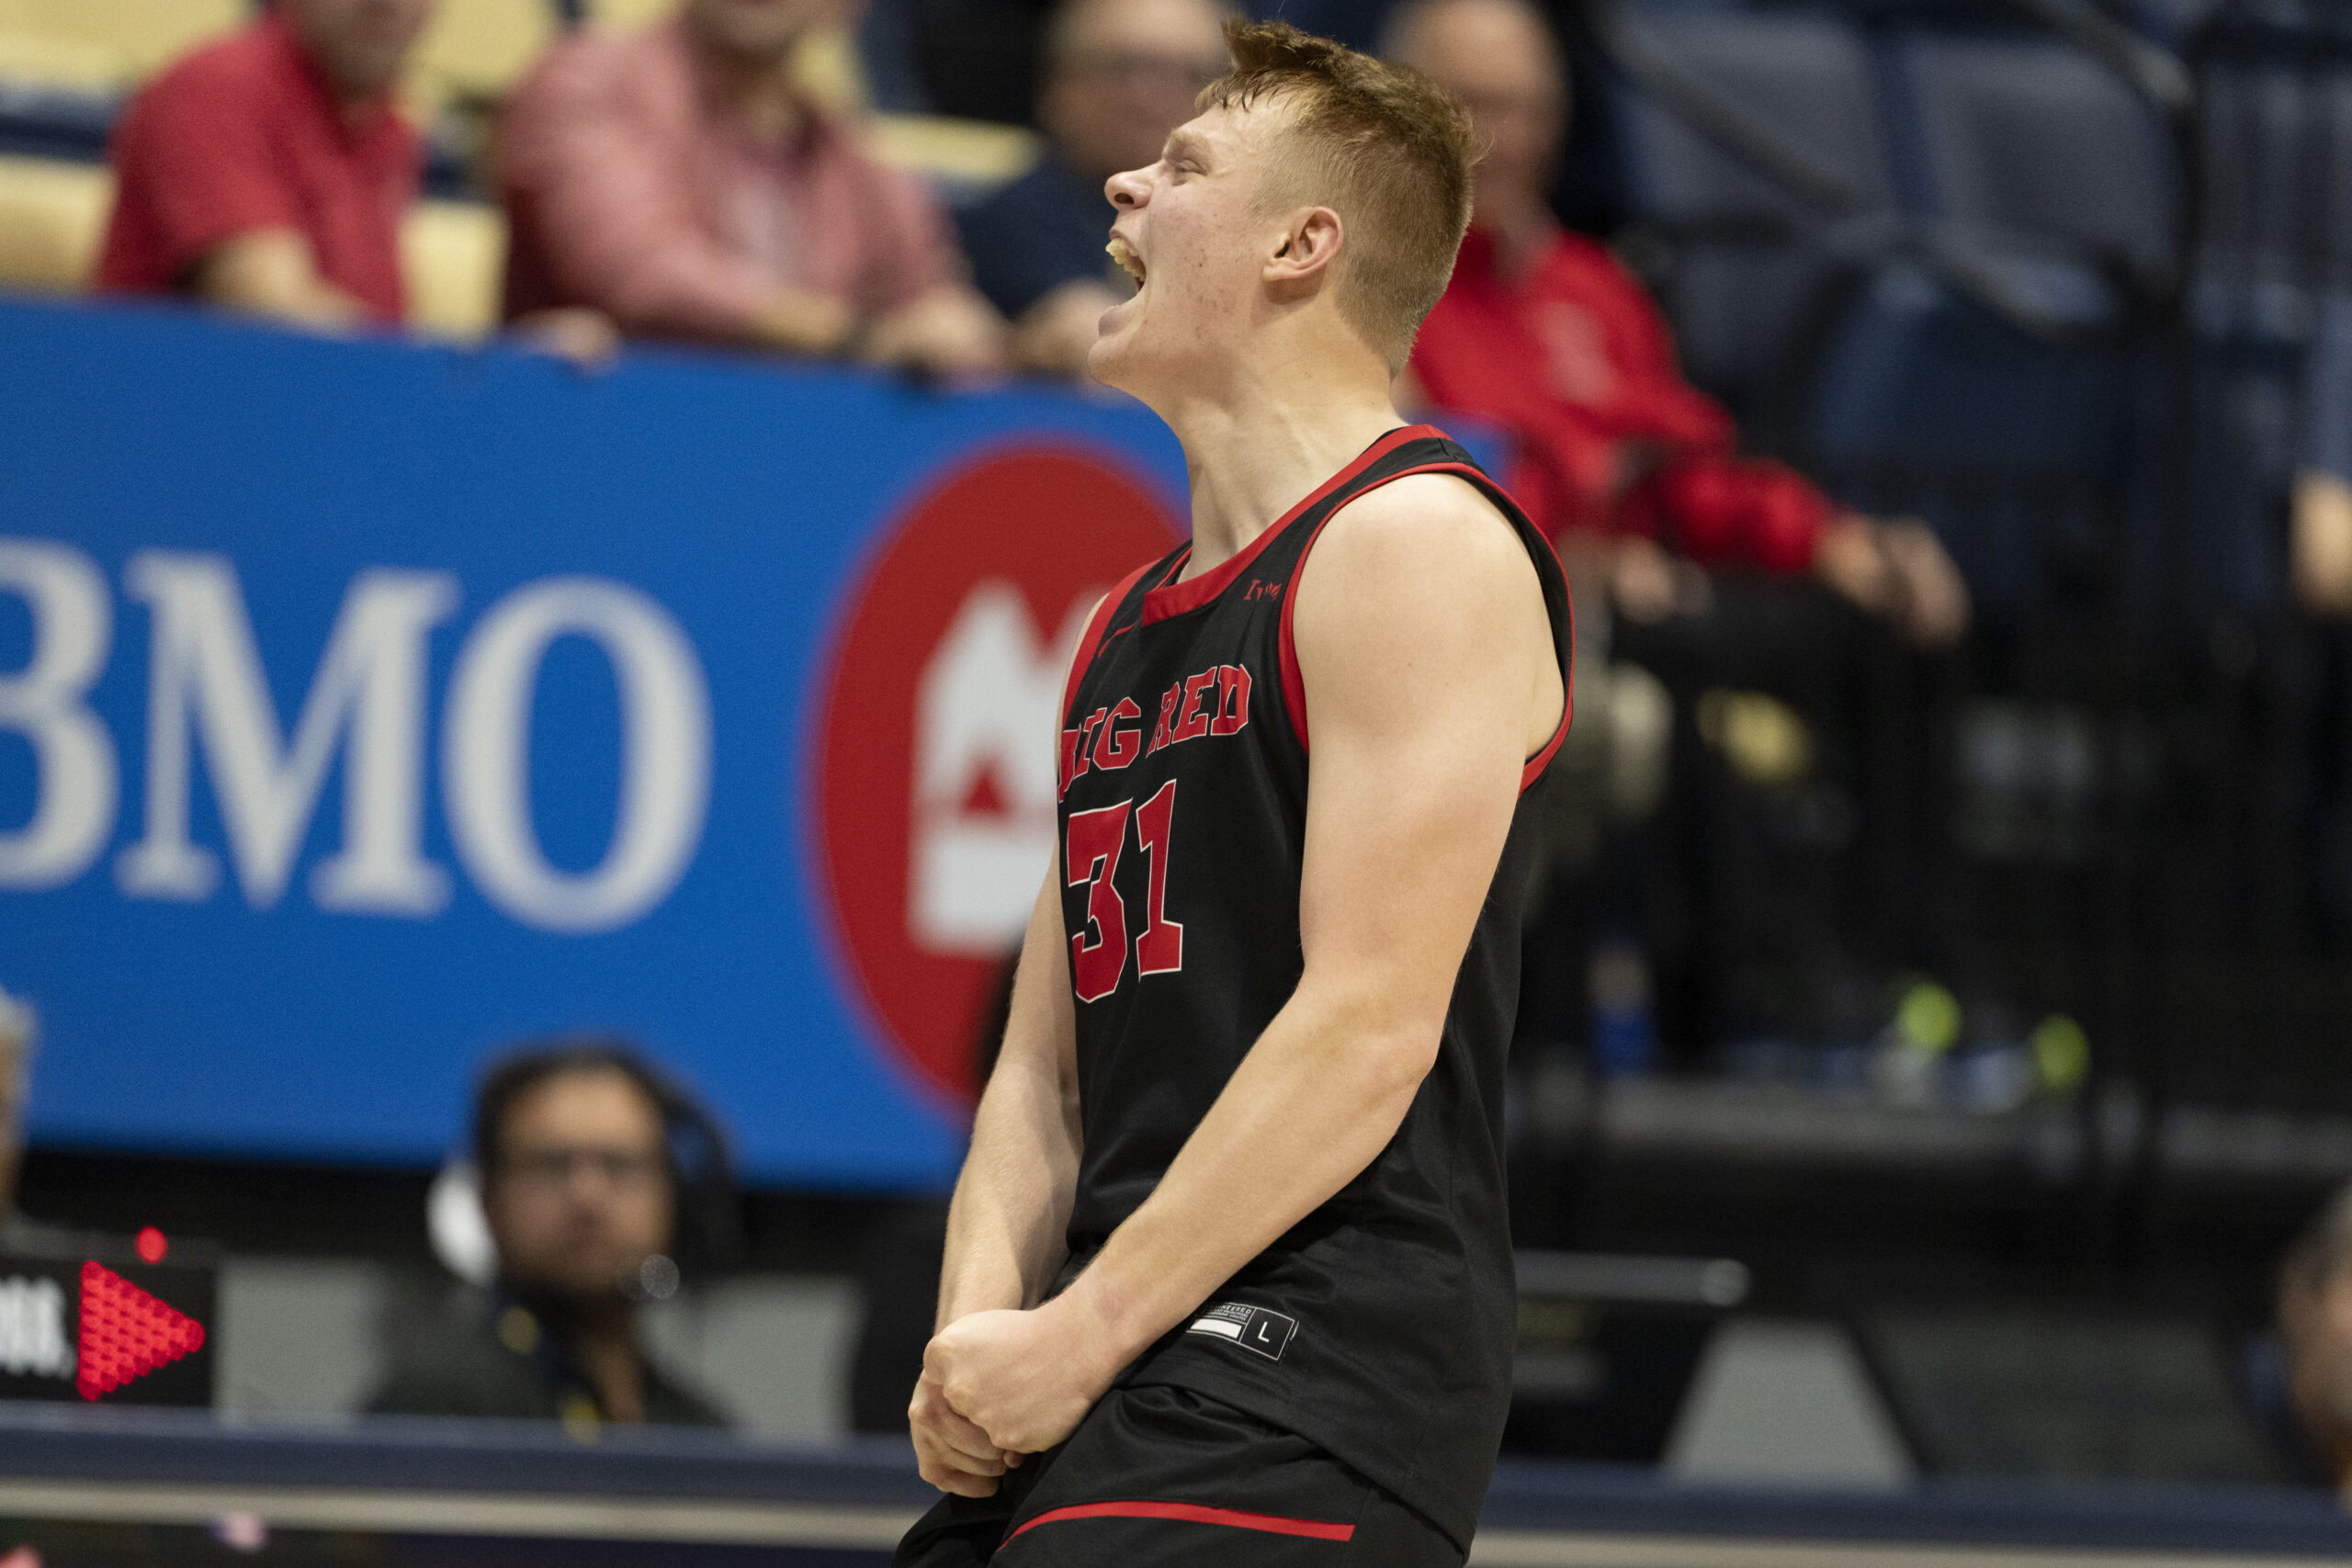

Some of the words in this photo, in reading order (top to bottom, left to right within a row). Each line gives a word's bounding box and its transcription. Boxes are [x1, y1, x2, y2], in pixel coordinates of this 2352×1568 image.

[0, 536, 715, 935] BMO
[1146, 663, 1251, 758] RED
[1067, 778, 1183, 1003] 31
[1257, 1321, 1270, 1343] L
